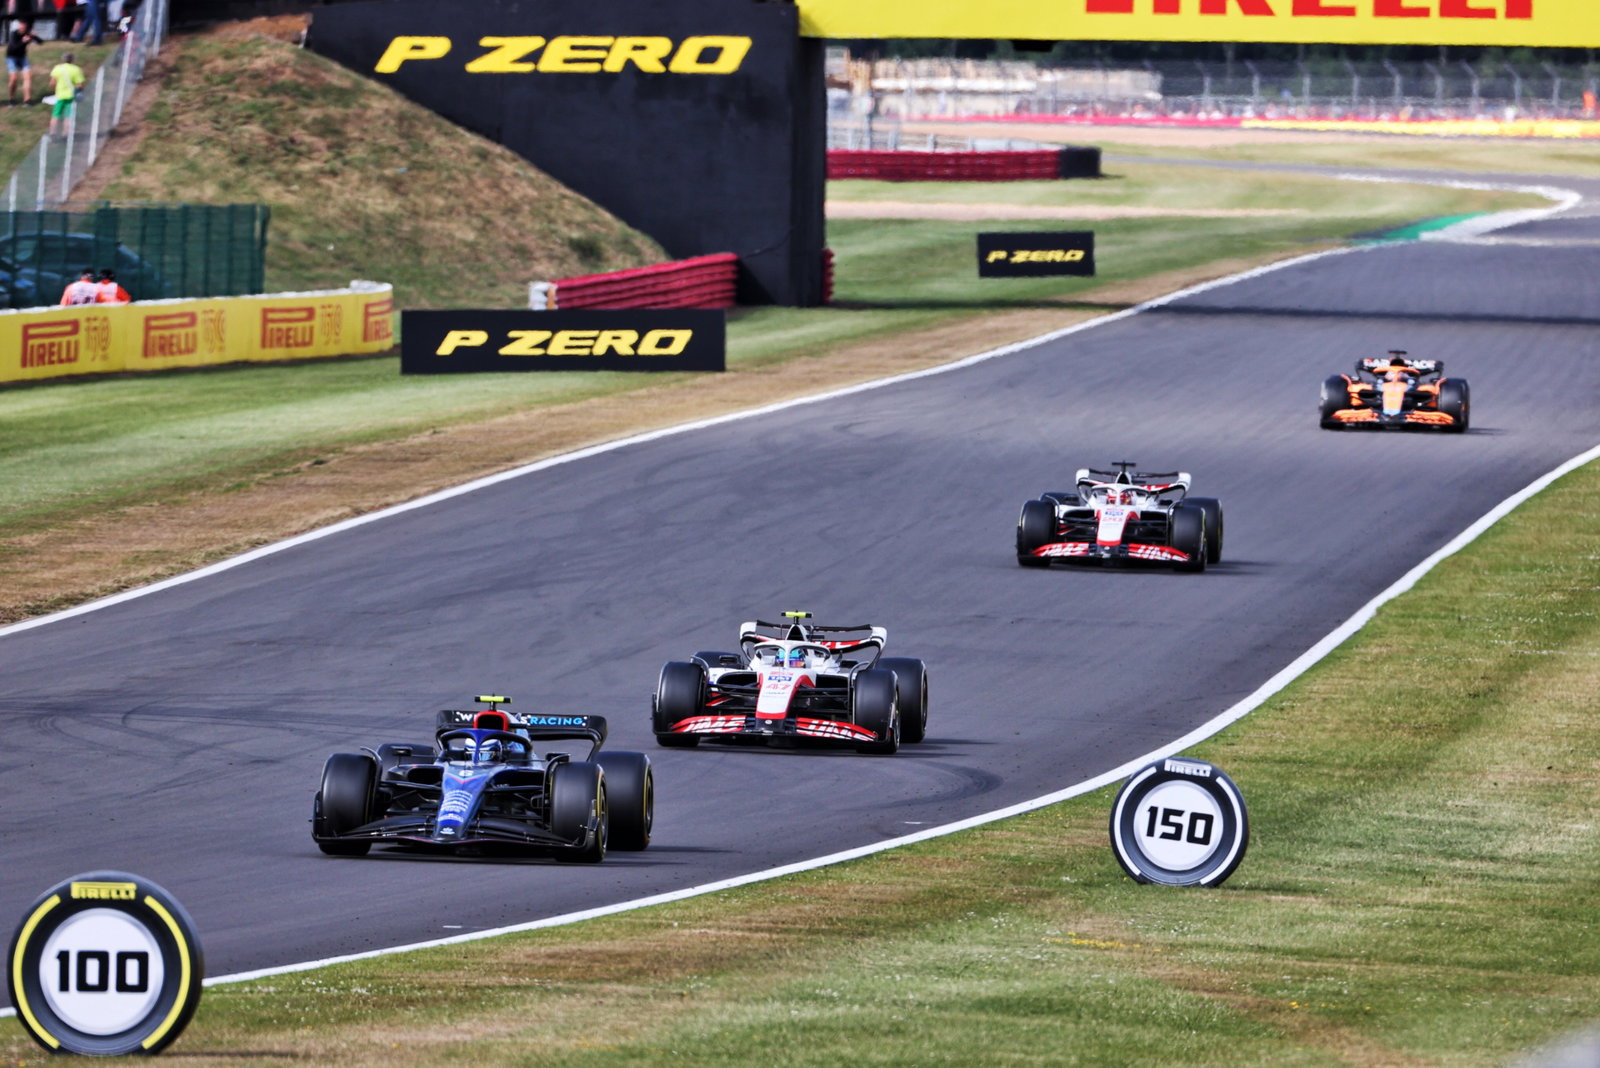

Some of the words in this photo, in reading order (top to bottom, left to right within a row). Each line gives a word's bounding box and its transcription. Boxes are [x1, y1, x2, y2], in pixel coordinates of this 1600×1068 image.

[374, 36, 452, 74] P
[465, 35, 752, 74] ZERO
[986, 250, 1008, 263] P
[1009, 249, 1085, 263] ZERO
[21, 319, 80, 368] PIRELLI
[143, 312, 197, 358] PIRELLI
[261, 307, 315, 349] PIRELLI
[436, 330, 489, 356] P
[498, 329, 693, 356] ZERO
[530, 716, 583, 725] RACING
[1164, 759, 1212, 777] PIRELLI
[1146, 805, 1214, 846] 150
[70, 881, 137, 899] PIRELLI
[56, 950, 149, 993] 100
